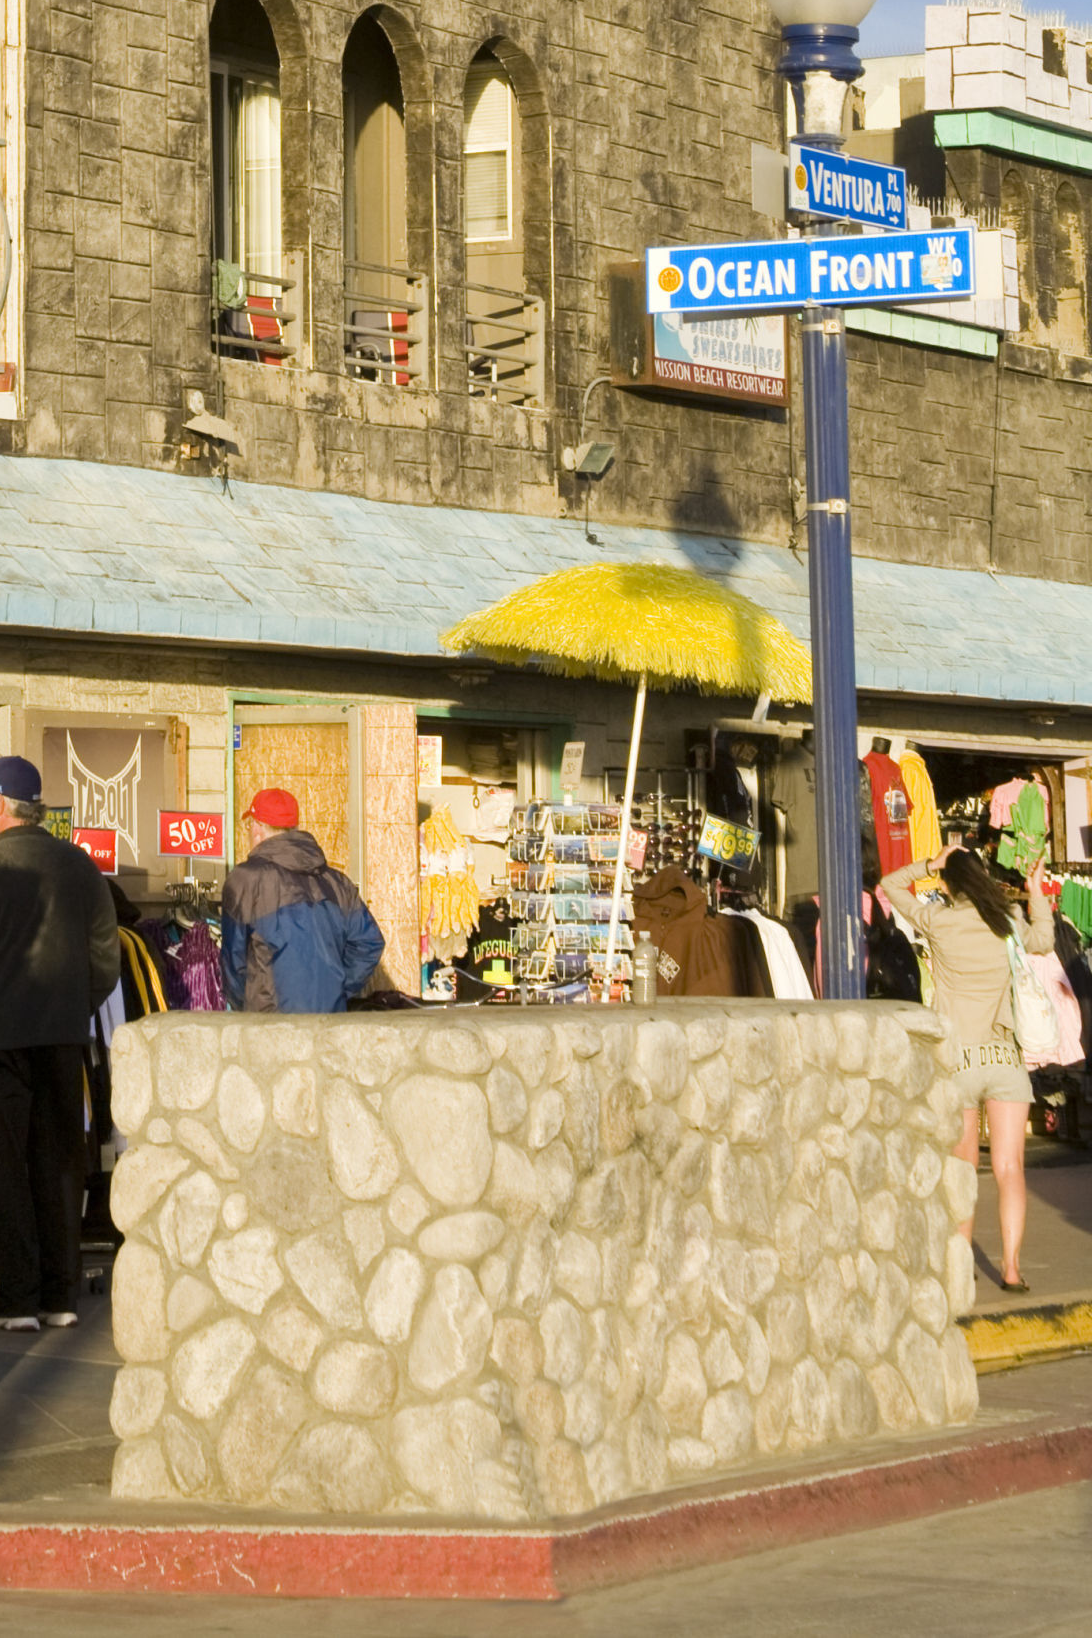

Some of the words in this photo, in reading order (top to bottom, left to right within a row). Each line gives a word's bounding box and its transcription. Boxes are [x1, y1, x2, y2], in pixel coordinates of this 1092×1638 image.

[809, 159, 886, 218] VENTURA
[887, 172, 900, 192] PL
[885, 193, 902, 214] 700
[687, 256, 797, 300] OCEAN
[809, 249, 915, 294] FRONT
[926, 235, 958, 256] WK
[693, 366, 725, 387] BEACH
[726, 372, 785, 398] RESORTWEAR
[93, 849, 112, 860] OFF
[190, 836, 215, 854] OFF
